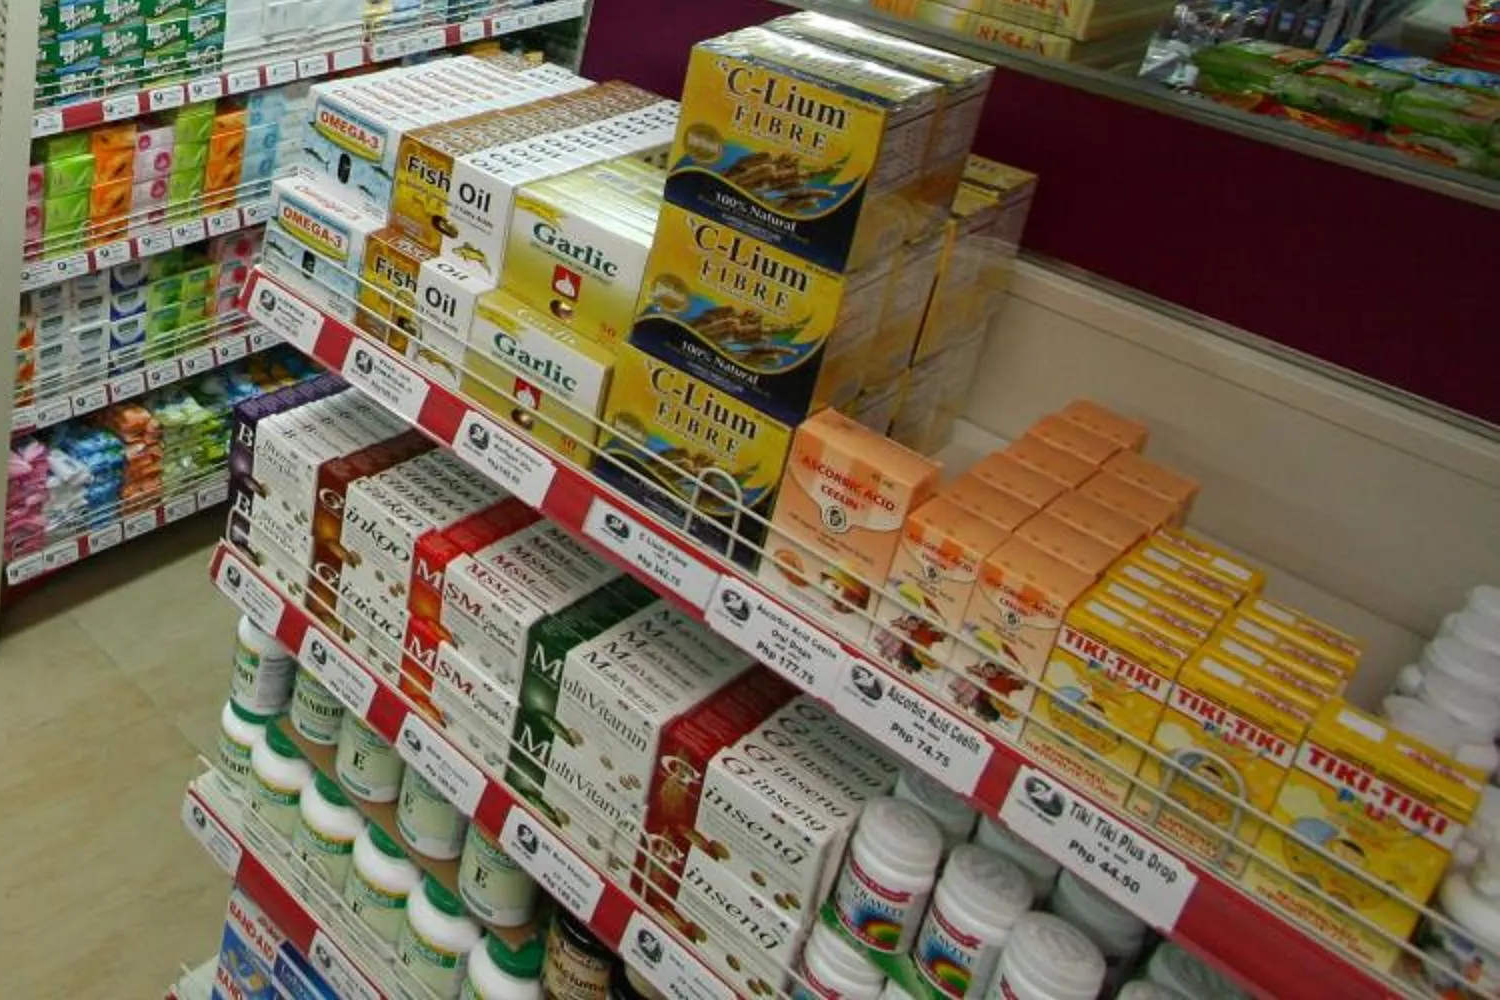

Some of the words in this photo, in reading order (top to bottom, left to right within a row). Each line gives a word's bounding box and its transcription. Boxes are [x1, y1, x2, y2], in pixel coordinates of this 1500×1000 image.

[727, 66, 847, 131] C-Lium
[320, 110, 379, 149] OMEGA-3
[735, 103, 828, 151] FIBRE
[407, 156, 451, 193] Fish
[459, 182, 491, 213] Oil
[716, 191, 749, 216] 100%
[750, 202, 797, 232] Natural
[283, 207, 343, 249] OMEGA-3
[532, 221, 619, 278] Garlic
[695, 224, 809, 292] C-Lium
[701, 259, 789, 307] FIBRE
[375, 257, 418, 294] Fish
[425, 286, 457, 318] Oil
[493, 331, 579, 392] Garlic
[682, 339, 712, 363] 100%
[714, 352, 759, 386] Natural
[651, 367, 758, 441] C-Lium
[658, 400, 741, 453] FIBRE
[864, 487, 896, 512] ACID
[416, 558, 483, 617] MSM
[466, 563, 510, 595] MSM
[493, 554, 536, 585] MSM
[410, 635, 475, 695] MSM
[756, 640, 778, 662] Php
[1064, 630, 1161, 692] TIKI-TIKI
[887, 685, 927, 721] Ascorbic
[927, 708, 950, 734] Acid
[1177, 687, 1285, 757] TIKI-TIKI
[889, 722, 914, 746] Php
[916, 740, 950, 768] 74.75
[722, 756, 828, 832] Ginseng
[1308, 746, 1448, 835] TIKI-TIKI
[1069, 838, 1096, 866] Php
[1099, 861, 1141, 894] 44.50
[1070, 802, 1094, 828] Tiki
[1096, 817, 1119, 843] Tiki
[1119, 830, 1146, 861] Plus
[1147, 850, 1178, 885] Drop
